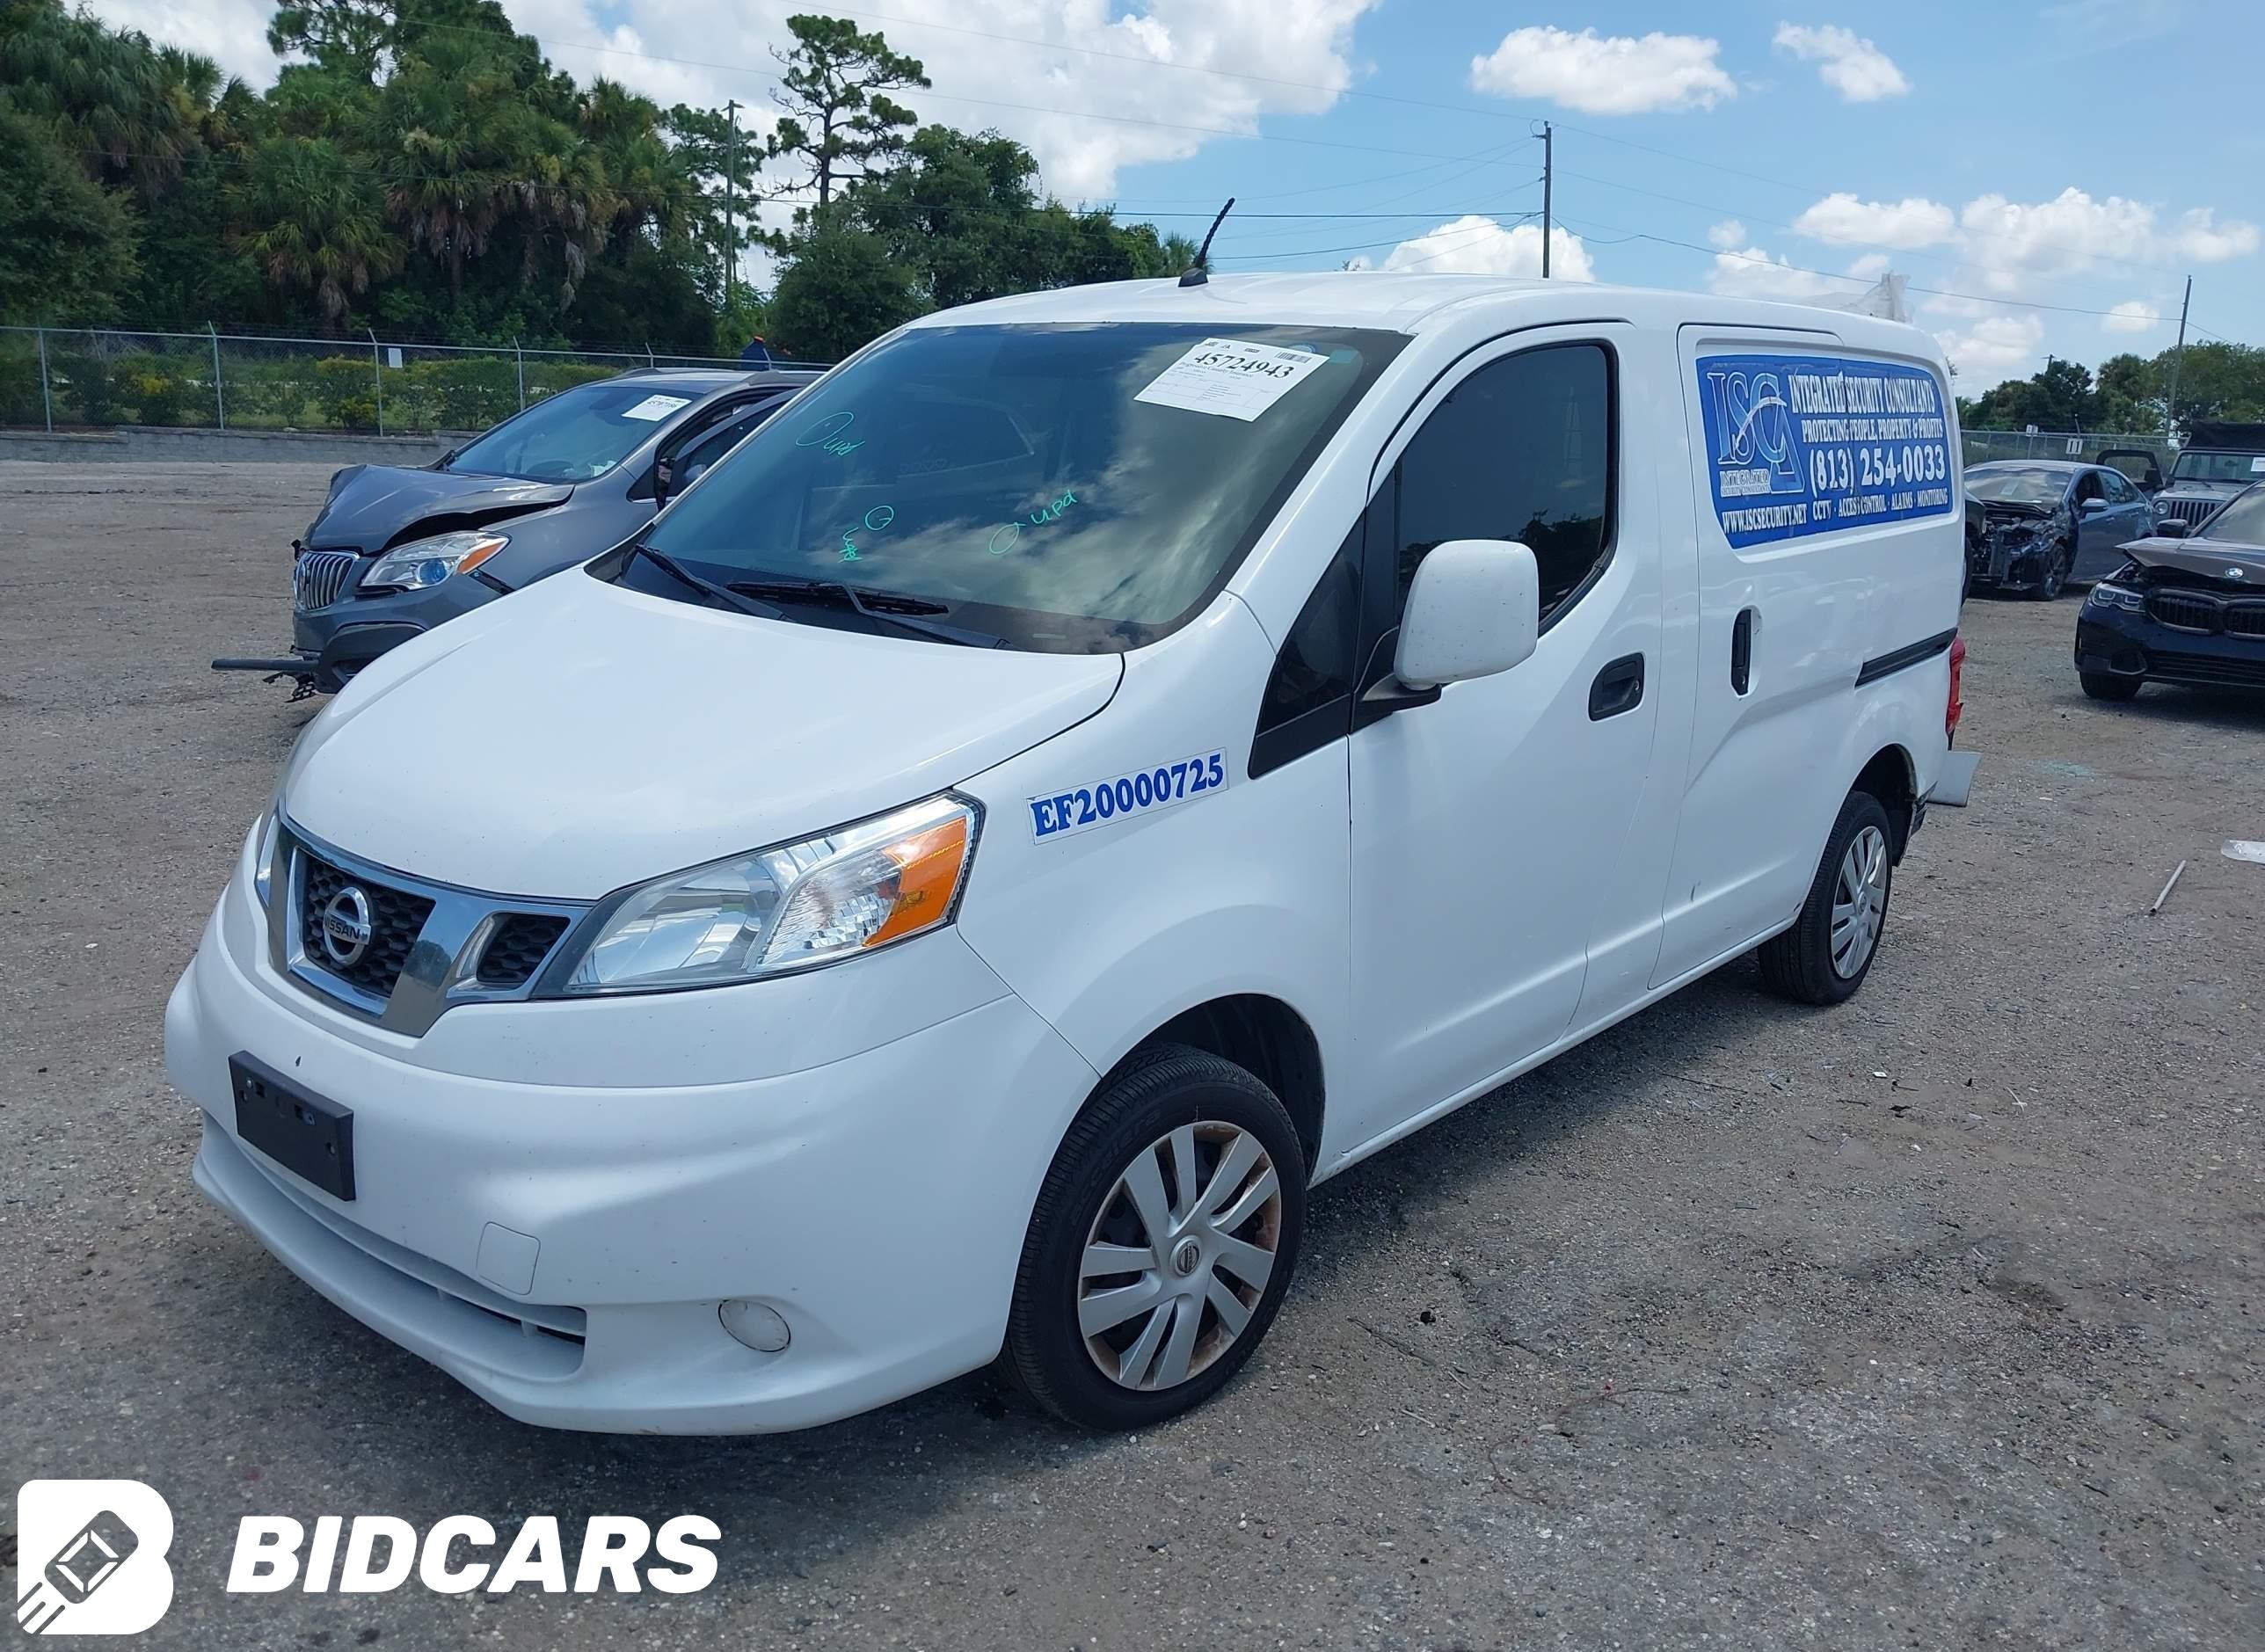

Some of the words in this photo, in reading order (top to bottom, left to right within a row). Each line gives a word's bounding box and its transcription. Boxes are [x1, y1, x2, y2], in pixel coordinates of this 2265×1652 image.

[1194, 352, 1294, 378] 45724943
[1788, 374, 1846, 414] INTEGRATED
[1846, 376, 1884, 414] SECURITY
[1884, 377, 1935, 414] CONSULTANTS
[1802, 419, 1850, 442] PROTECTING
[1877, 418, 1912, 440] PROPERTY
[1918, 418, 1943, 439] PROFITS
[1810, 448, 1854, 499] (813)
[1860, 444, 1946, 487] 254-0033
[1722, 504, 1808, 535] WWW.ISCSECURITY.NET
[1812, 499, 1832, 521] CCTV
[1838, 496, 1861, 517] ACCESS
[1860, 494, 1887, 516] CONTROL
[1891, 491, 1913, 511] ALARMS
[1917, 488, 1948, 507] MONITORING
[1030, 753, 1224, 837] EF20000725
[324, 917, 361, 940] NISSAN
